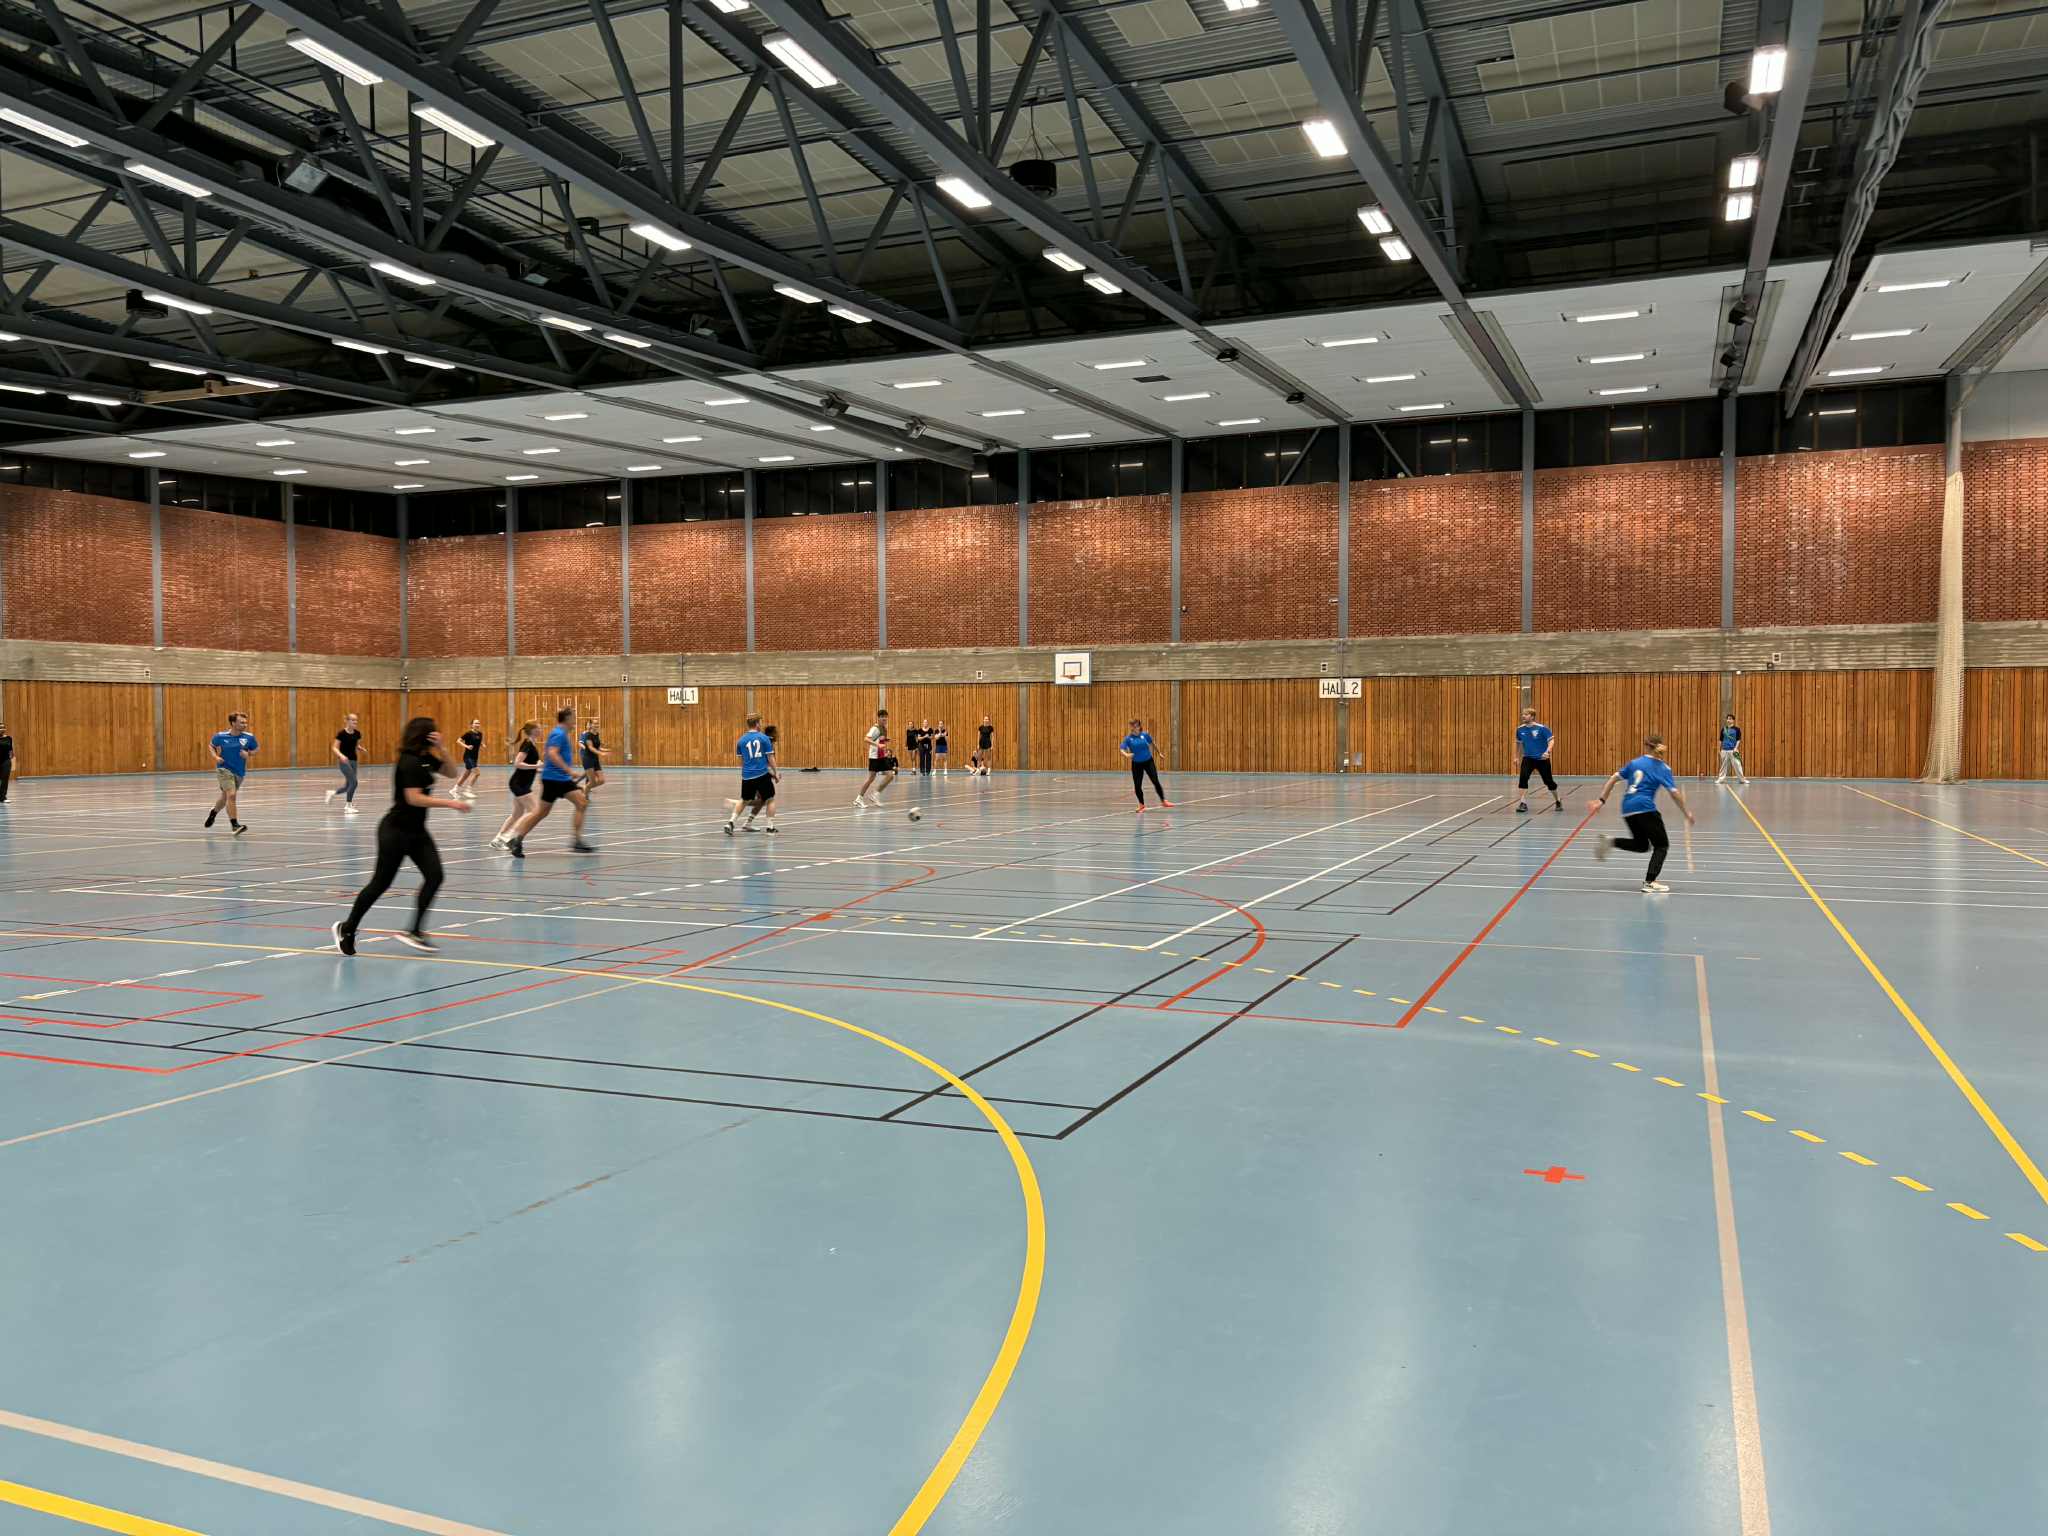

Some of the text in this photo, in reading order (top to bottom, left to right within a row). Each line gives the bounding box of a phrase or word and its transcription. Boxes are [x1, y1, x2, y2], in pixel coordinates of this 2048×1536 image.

[1322, 681, 1359, 695] HALL 2
[745, 739, 762, 759] 12
